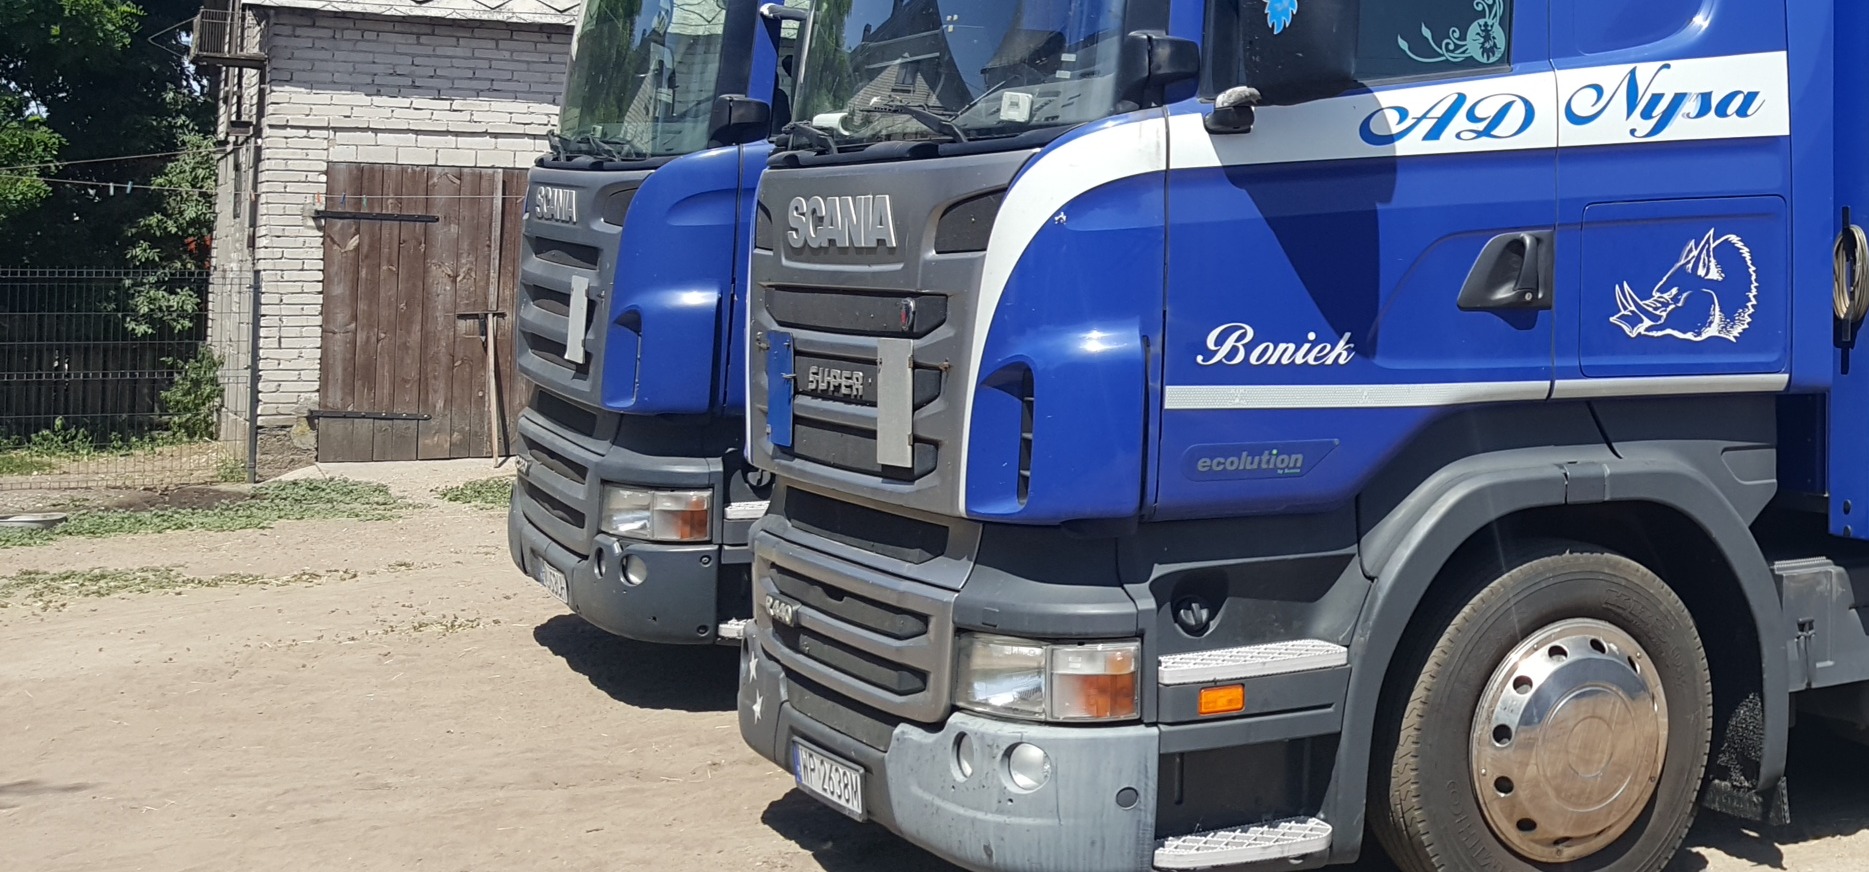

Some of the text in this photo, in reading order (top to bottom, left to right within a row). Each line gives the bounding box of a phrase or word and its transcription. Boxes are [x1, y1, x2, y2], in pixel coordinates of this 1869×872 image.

[1359, 92, 1535, 146] AD
[535, 186, 577, 223] SCANIA
[787, 194, 897, 249] SCANIA
[1196, 322, 1355, 365] Boniek
[808, 366, 864, 398] SUPER
[1197, 449, 1303, 471] ecolution
[801, 748, 863, 813] WP 2638M
